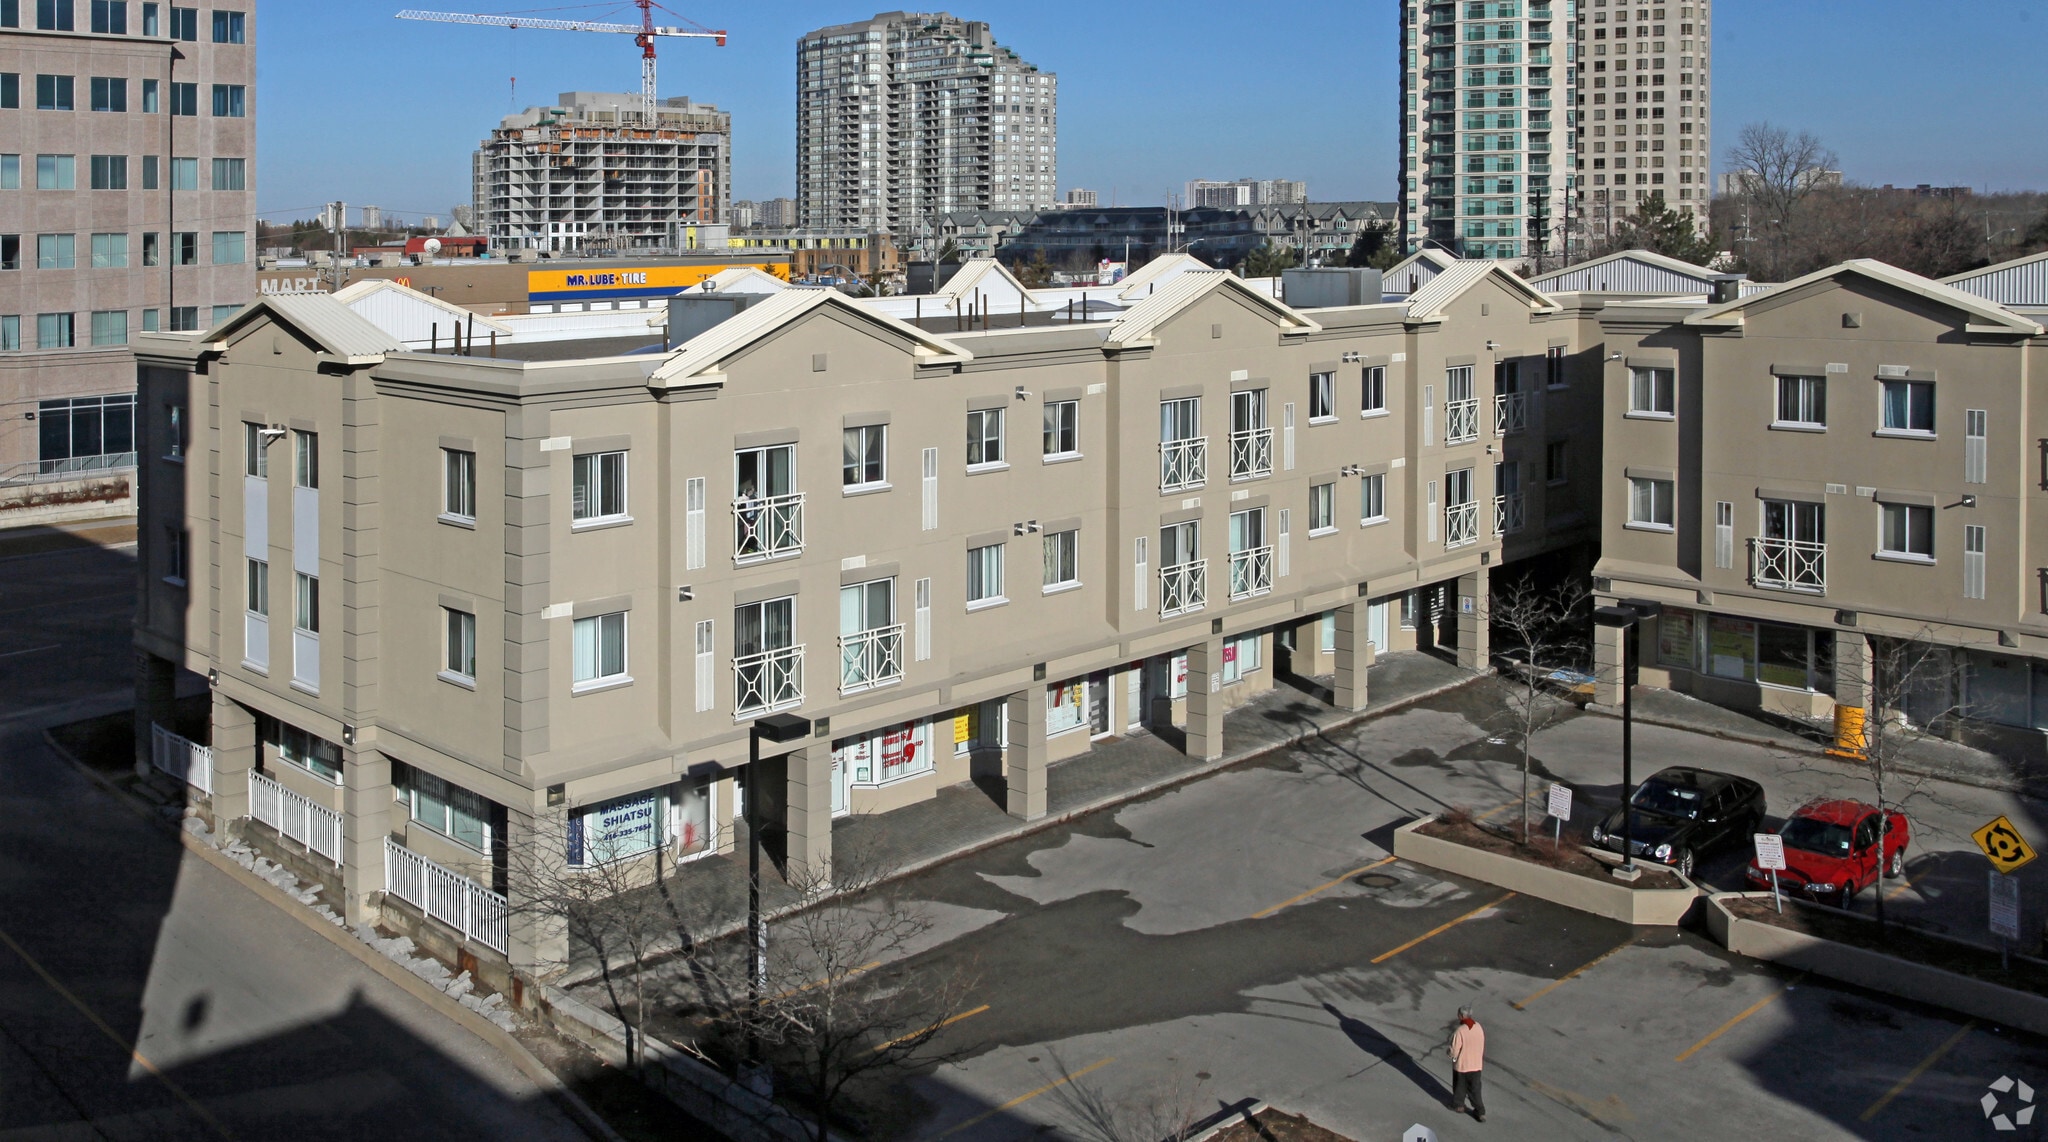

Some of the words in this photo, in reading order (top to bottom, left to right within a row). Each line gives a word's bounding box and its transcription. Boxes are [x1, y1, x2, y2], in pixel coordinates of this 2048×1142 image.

[567, 274, 588, 286] MR.
[590, 273, 615, 286] LUBE
[621, 272, 647, 284] TIRE
[600, 792, 656, 815] MASSAGE
[603, 806, 653, 828] SHIATSU
